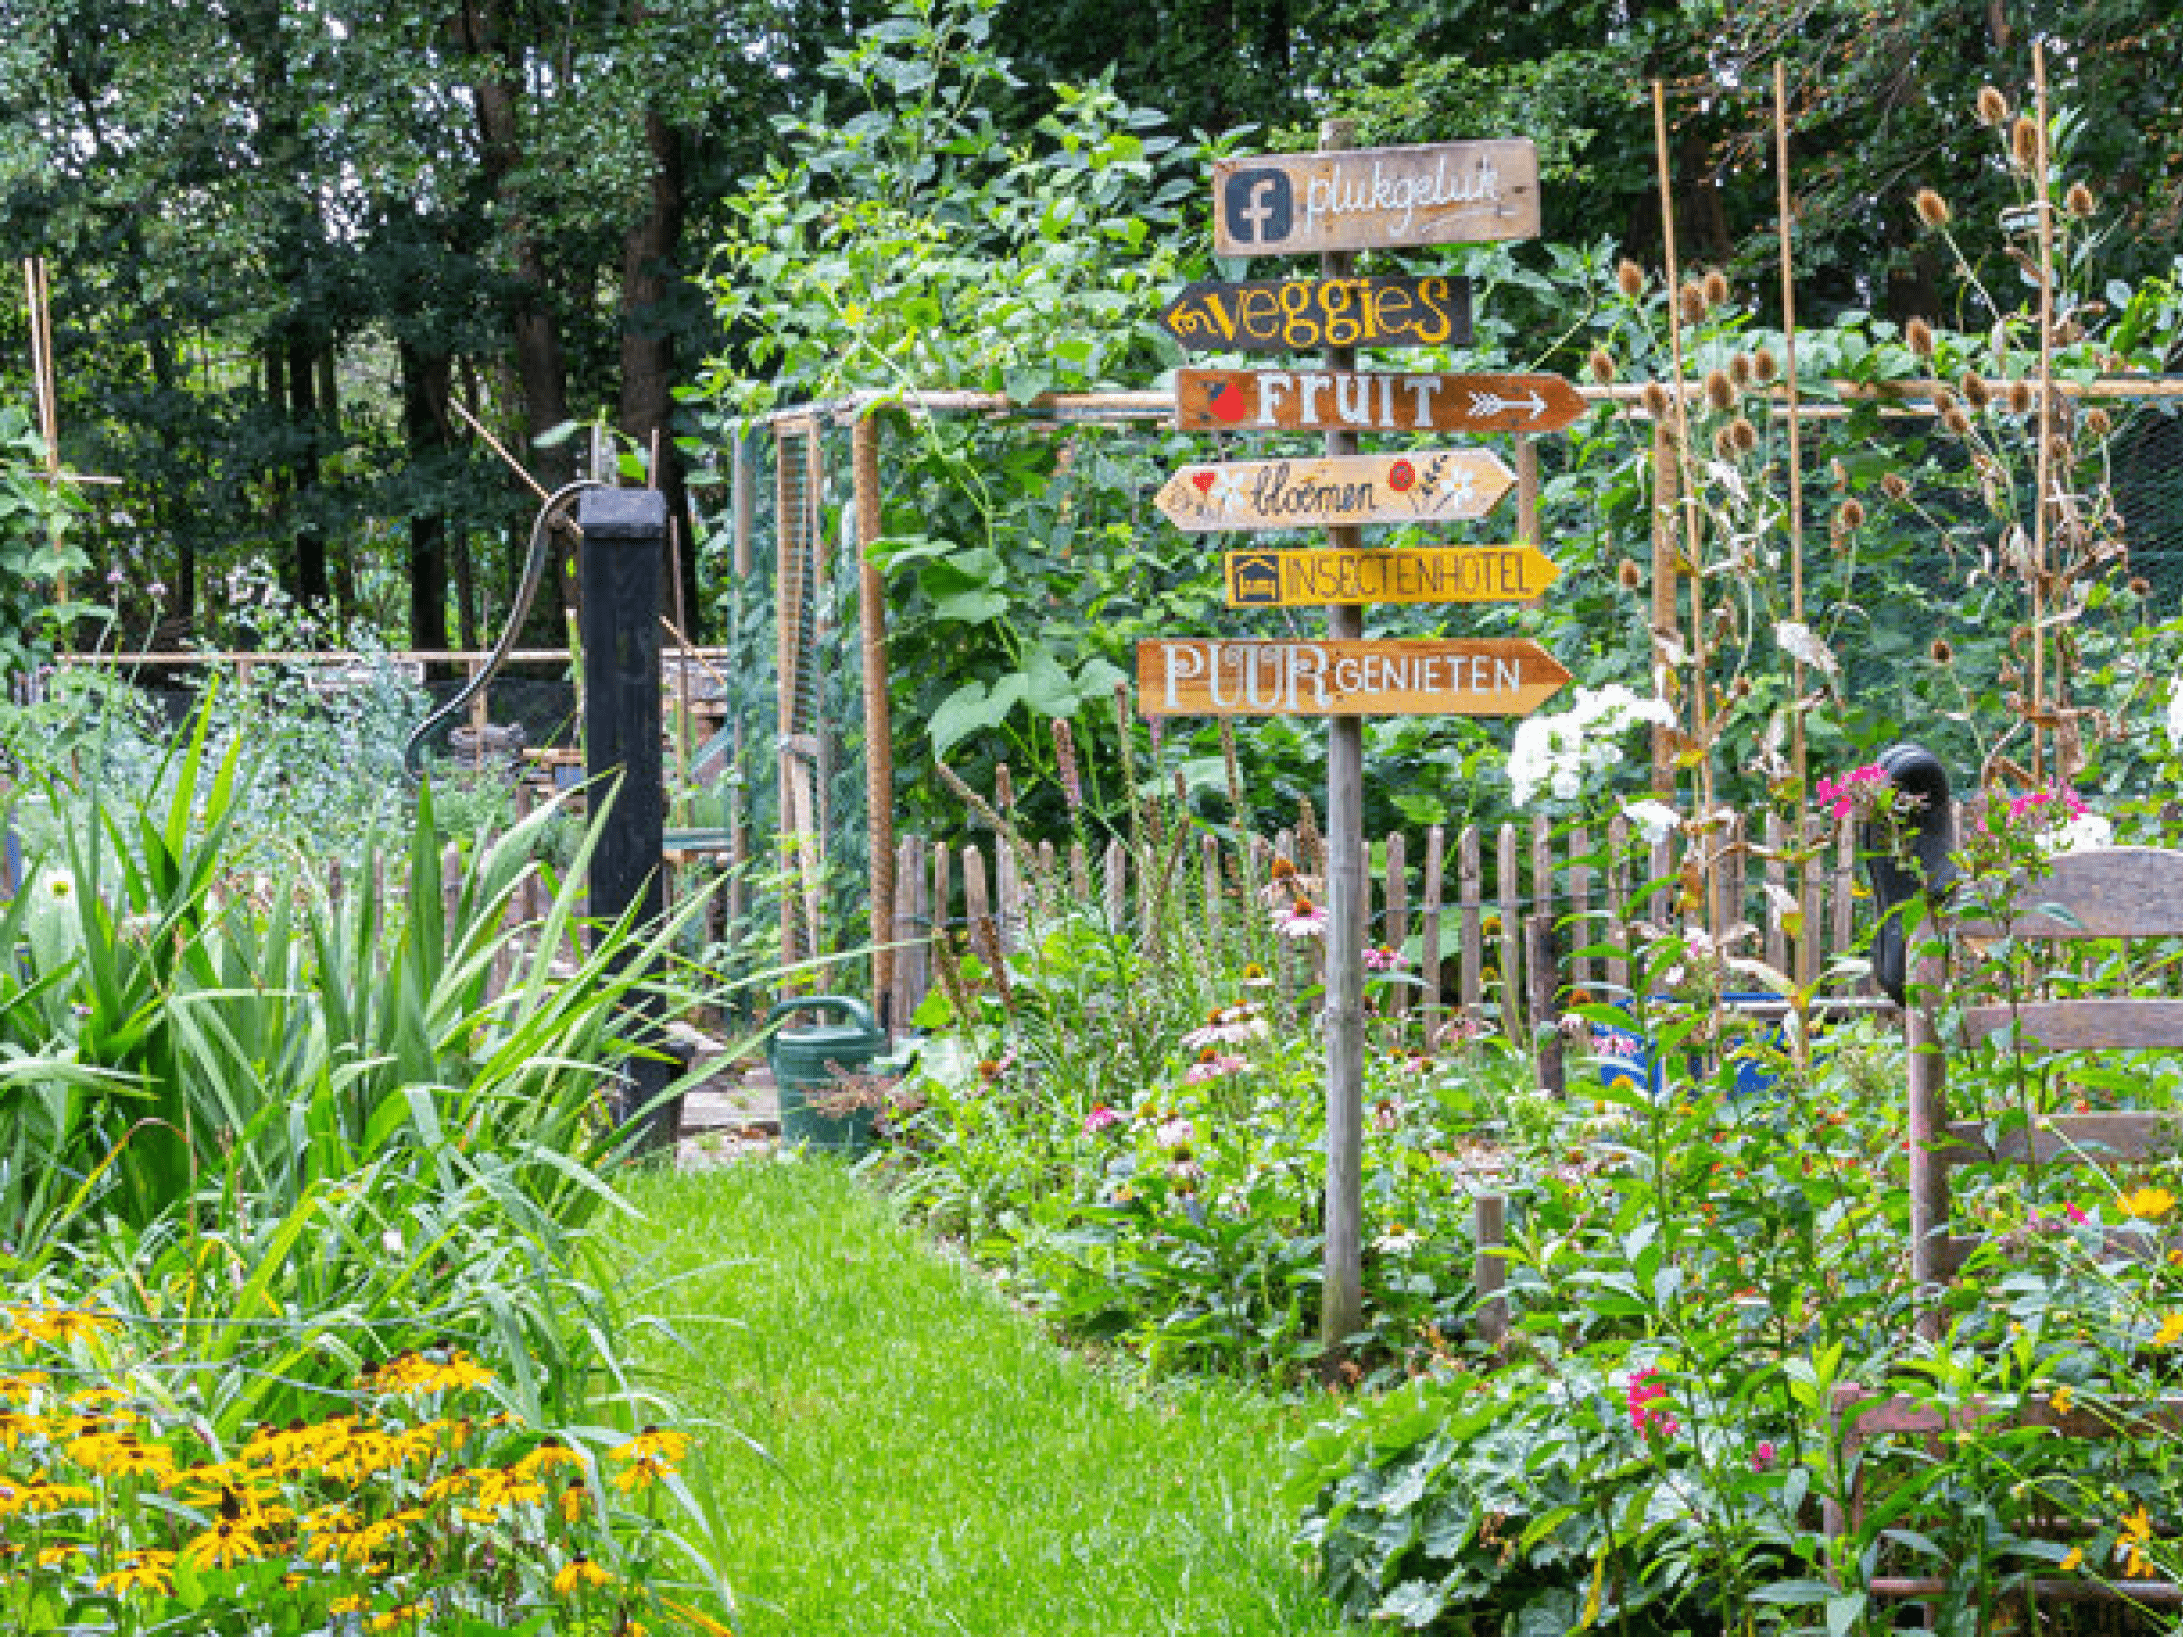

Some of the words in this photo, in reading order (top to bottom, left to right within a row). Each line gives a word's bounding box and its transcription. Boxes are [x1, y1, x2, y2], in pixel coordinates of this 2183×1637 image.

[1305, 153, 1500, 237] plukgeluk
[1252, 461, 1378, 516] bloemen
[1285, 551, 1532, 599] INSECTENHOTEL
[1161, 644, 1333, 710] PUUR
[1335, 655, 1521, 695] GENIETEN
